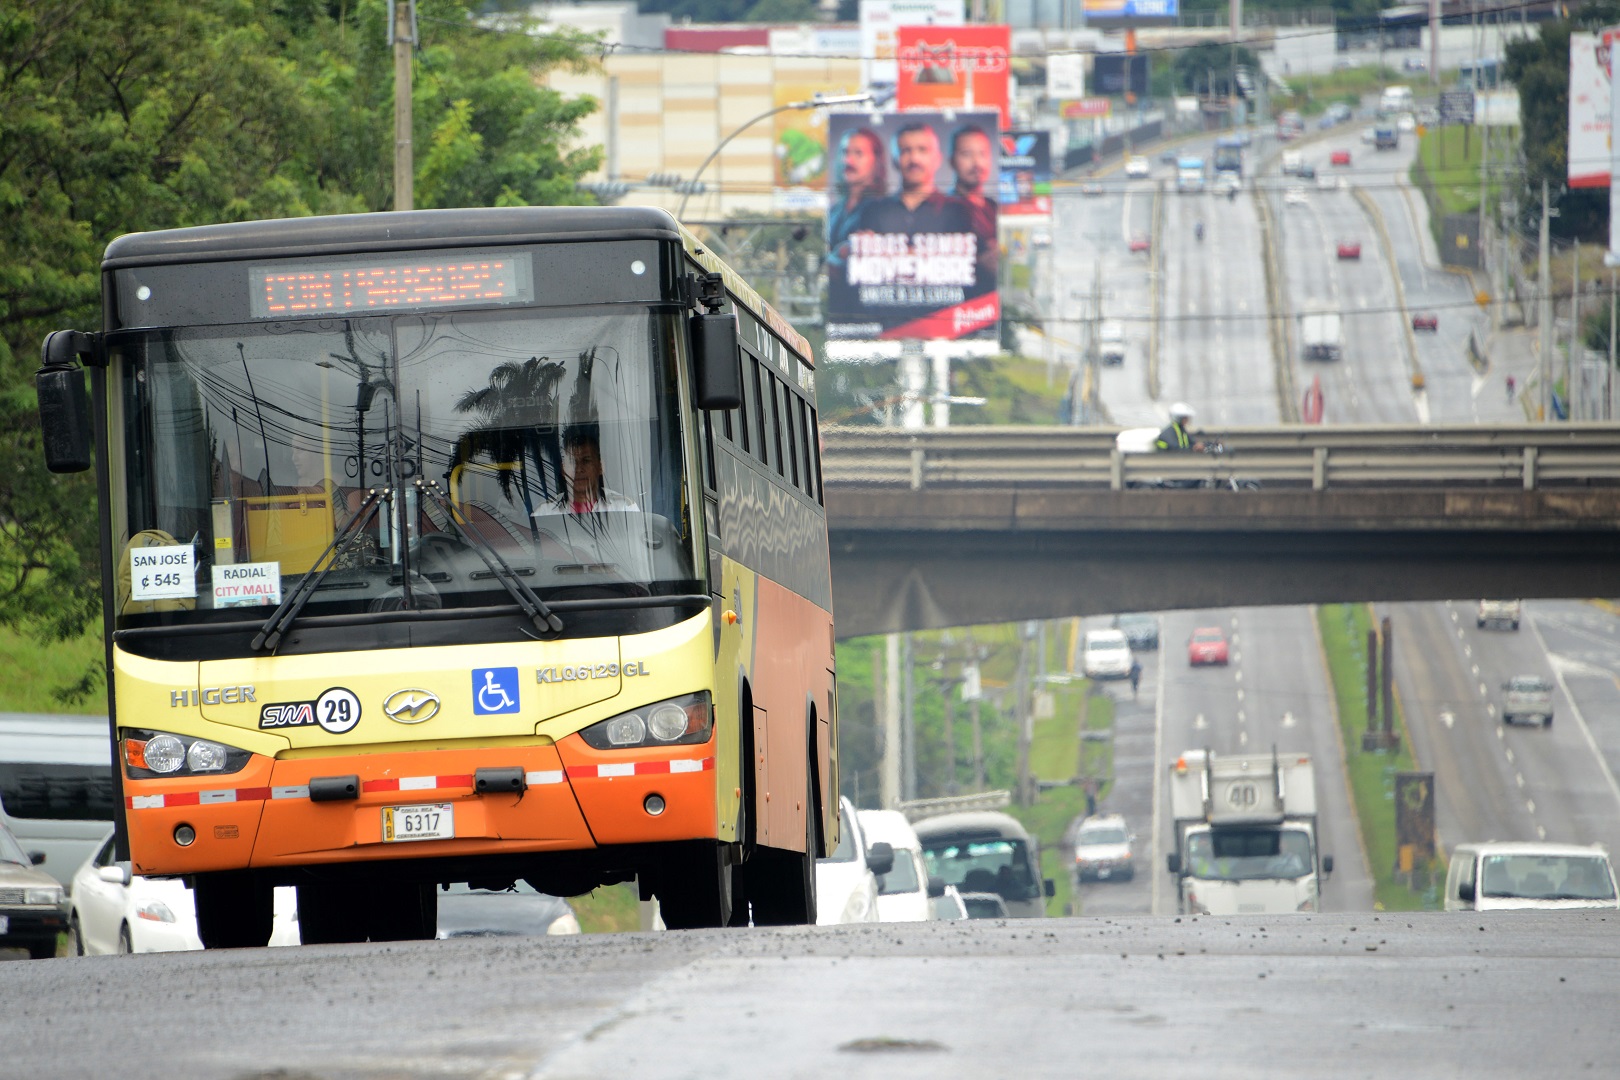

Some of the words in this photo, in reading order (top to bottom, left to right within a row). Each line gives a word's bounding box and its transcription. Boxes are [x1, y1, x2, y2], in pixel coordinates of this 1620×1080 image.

[134, 556, 156, 567] SAN
[160, 552, 187, 566] JOSÉ
[154, 573, 181, 587] 545
[224, 568, 266, 579] RADIAL
[215, 585, 240, 597] CITY
[243, 583, 275, 595] MALL
[170, 685, 257, 708] HIGER
[324, 699, 351, 724] 29
[1230, 786, 1256, 807] 40
[405, 812, 440, 832] 6317
